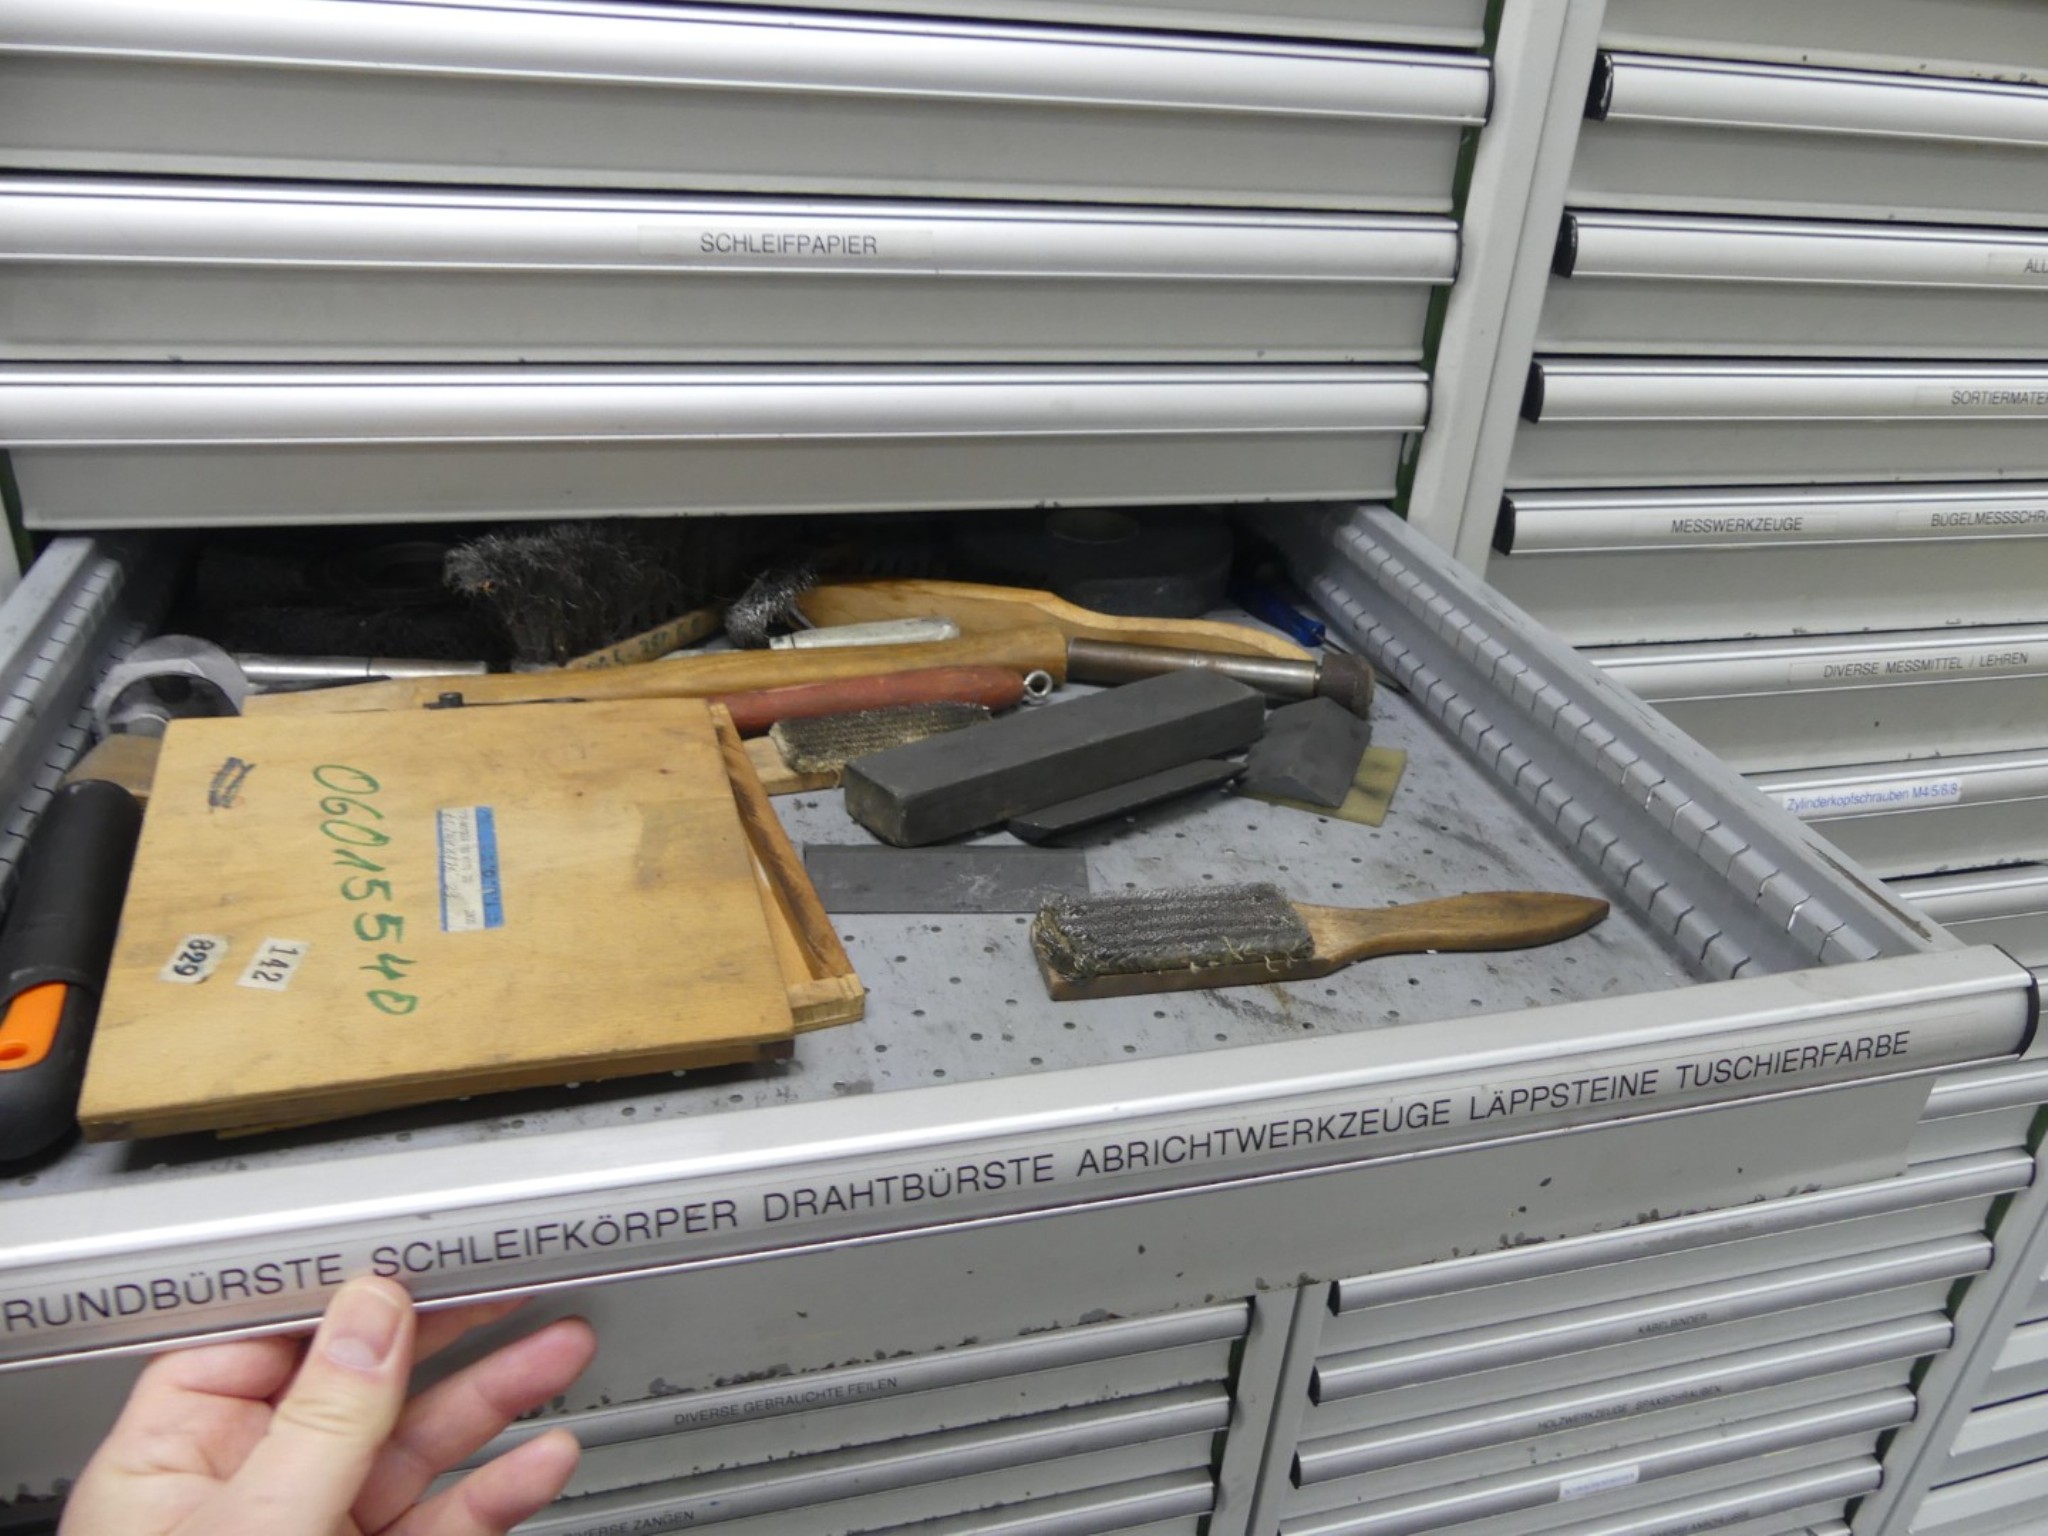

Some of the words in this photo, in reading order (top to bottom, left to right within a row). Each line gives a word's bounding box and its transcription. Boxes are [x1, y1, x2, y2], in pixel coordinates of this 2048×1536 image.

[700, 232, 878, 255] SCHLEIFPAPIER
[1951, 389, 2048, 406] SORTIERMATE
[1671, 516, 1804, 533] MESSWERKZEUGE
[1930, 509, 2048, 527] BÜGELMESSSCHR
[1823, 662, 1880, 678] DIVERSE
[1885, 657, 1963, 674] MESSMITTEL
[1979, 652, 2029, 668] LEHREN
[1786, 789, 1909, 814] Zylinderkopfschrauben
[173, 938, 216, 977] 829
[251, 944, 299, 983] 142
[3, 1253, 345, 1332] RUNDBÜRSTE
[371, 1199, 738, 1277] SCHLEIFKÖRPER
[763, 1153, 1054, 1222] DRAHTBÜRSTE
[1076, 1099, 1452, 1177] ABRICHTWERKZEUGE
[1469, 1070, 1659, 1120] LÄPPSTEINE
[1676, 1031, 1911, 1089] TUSCHIERFARBE
[674, 1403, 740, 1425] DIVERSE
[743, 1385, 844, 1413] GEBRAUCHTE
[849, 1376, 898, 1393] FEILEN
[633, 1510, 694, 1531] ZANGEN
